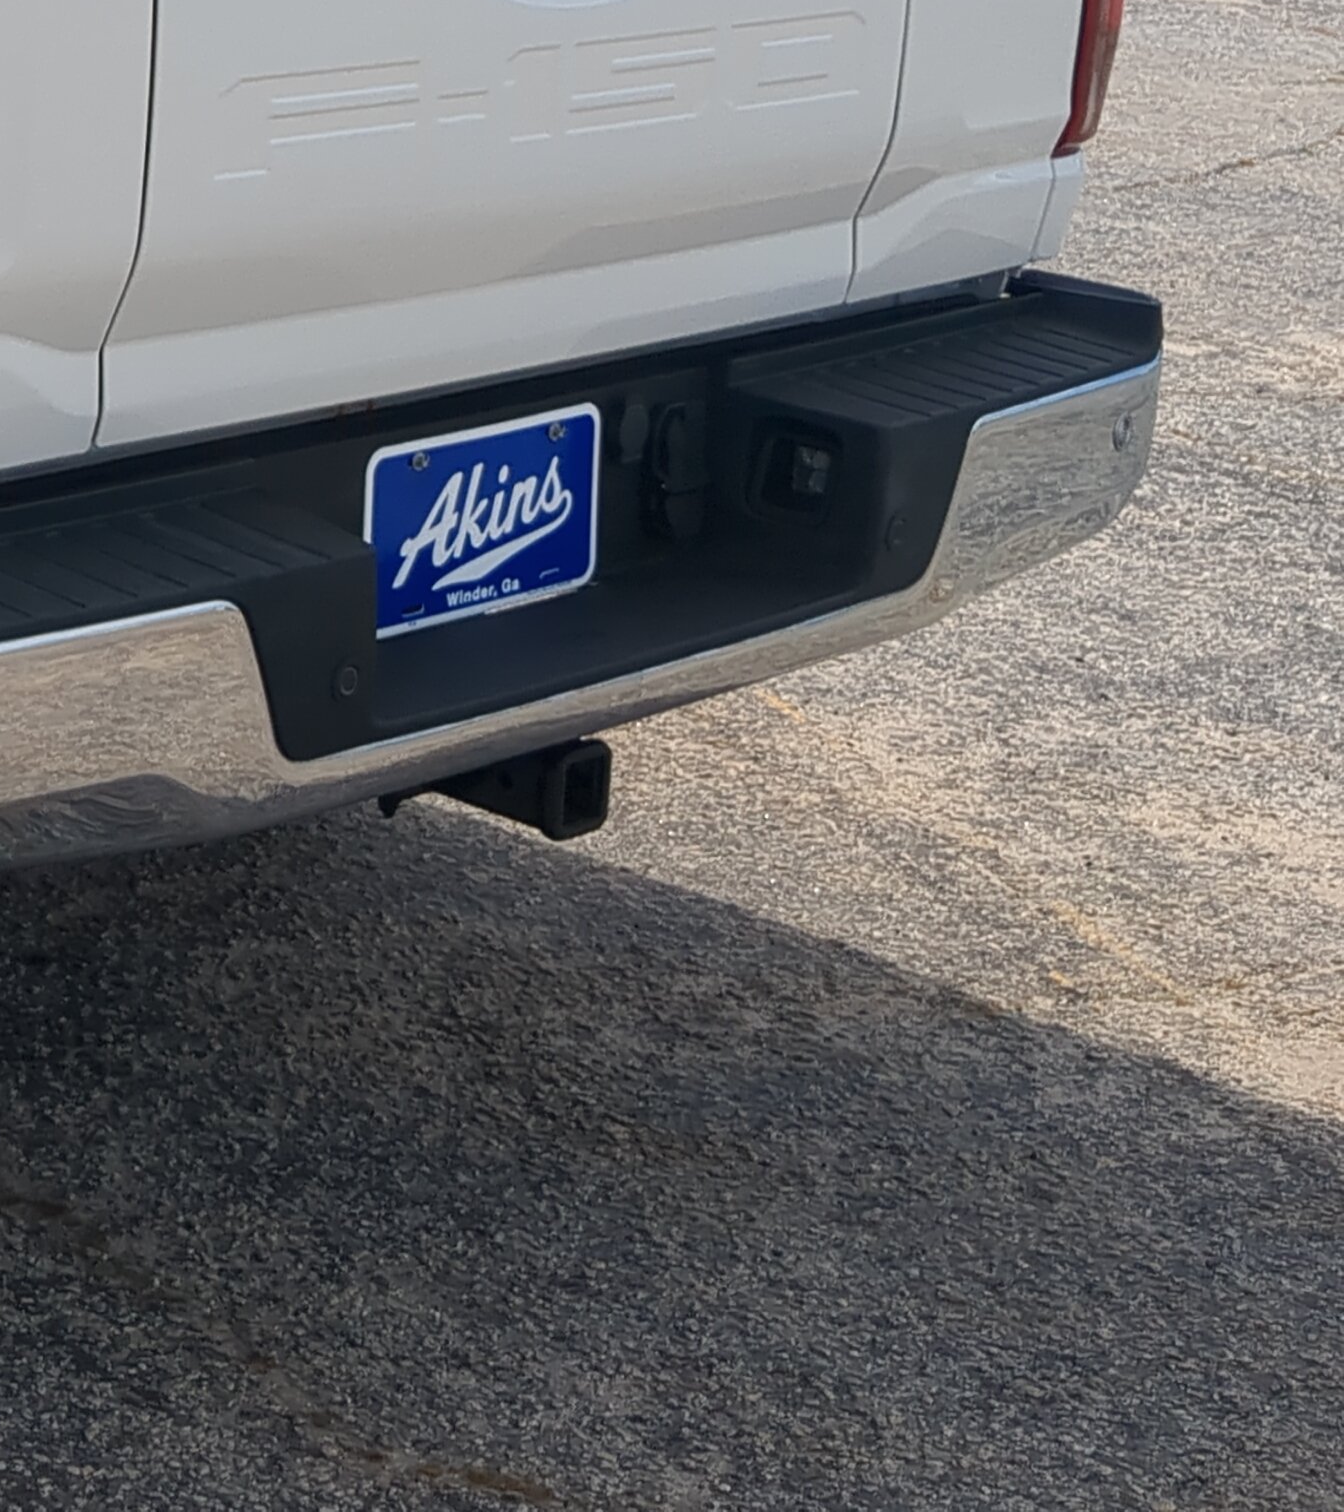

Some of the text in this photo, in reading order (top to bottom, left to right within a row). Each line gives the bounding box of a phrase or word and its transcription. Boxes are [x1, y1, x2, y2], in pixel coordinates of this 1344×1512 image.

[392, 455, 572, 590] Akins
[446, 577, 520, 607] Winder, Ga
